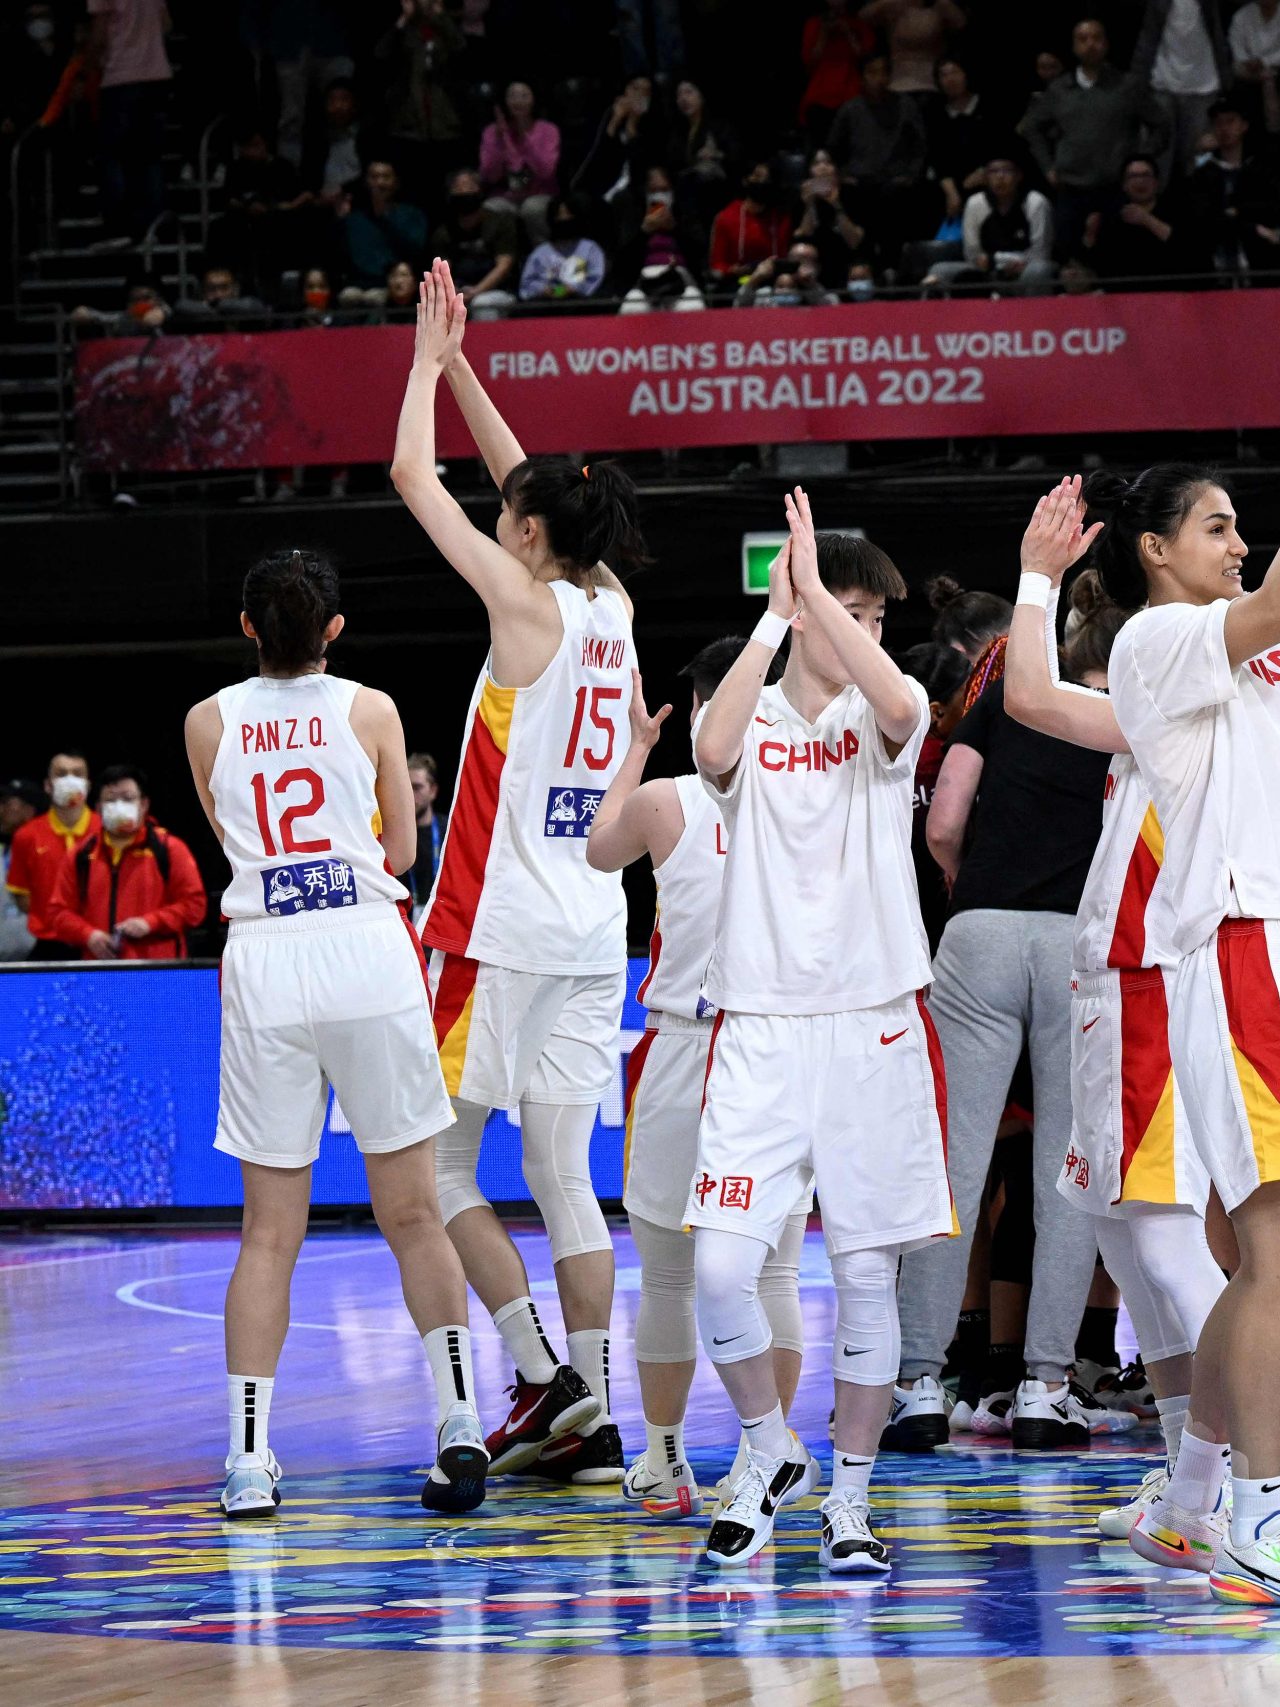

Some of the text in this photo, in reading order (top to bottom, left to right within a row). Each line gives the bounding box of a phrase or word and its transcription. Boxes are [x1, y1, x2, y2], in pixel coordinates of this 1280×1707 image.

[489, 327, 1127, 379] FIBA WOMEN'S BASKETBALL WORLD CUP
[629, 367, 985, 416] AUSTRALIA 2022
[606, 639, 626, 669] XU
[241, 720, 280, 754] PAN
[563, 686, 623, 771] 15
[758, 729, 860, 773] CHINA
[250, 767, 332, 857] 12
[303, 862, 353, 897] 秀域
[1065, 1145, 1090, 1190] 中国
[695, 1172, 754, 1211] 中国
